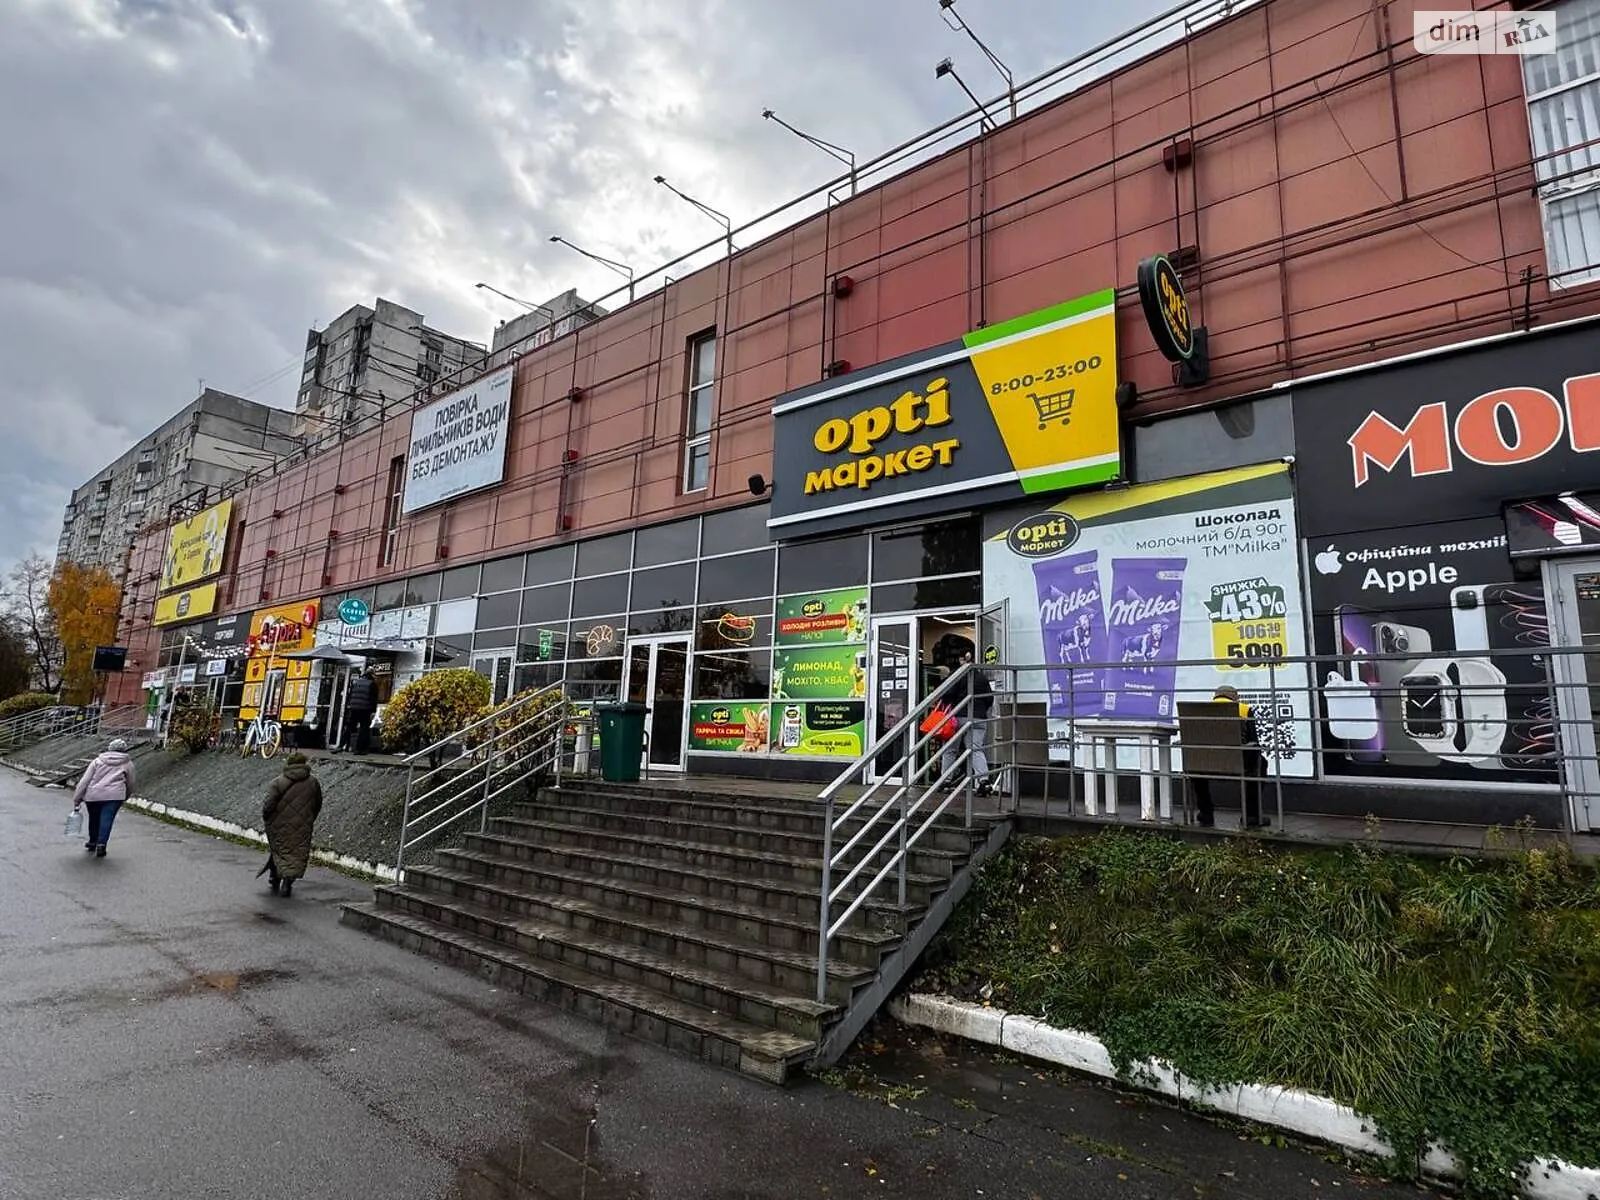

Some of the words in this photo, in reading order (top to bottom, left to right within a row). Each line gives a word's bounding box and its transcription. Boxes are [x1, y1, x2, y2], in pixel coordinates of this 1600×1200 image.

[1160, 271, 1188, 332] opti
[990, 355, 1102, 396] 8:00-23:00
[435, 393, 478, 429] ПОВІРКА
[813, 377, 952, 454] opti
[410, 416, 474, 460] ЛІЧИЛЬНИКІВ
[475, 401, 507, 432] ВОДИ
[412, 458, 430, 480] БЕЗ
[431, 430, 498, 477] ДЕМОНТАЖУ
[803, 438, 960, 495] маркет
[1017, 517, 1067, 542] opti
[1195, 508, 1281, 528] Шоколад
[1020, 539, 1065, 552] маркет
[1136, 528, 1219, 550] молочний
[1224, 525, 1252, 541] б/д
[1255, 523, 1288, 537] 90г
[1345, 544, 1432, 563] Офіційна
[1212, 579, 1268, 596] ЗНИЖКА
[1361, 562, 1458, 593] Apple
[804, 602, 823, 614] opti
[1040, 587, 1100, 624] Milka
[1109, 595, 1180, 625] Milka
[1209, 589, 1286, 623] -43%
[1236, 623, 1267, 639] 106
[825, 676, 849, 684] КВАС
